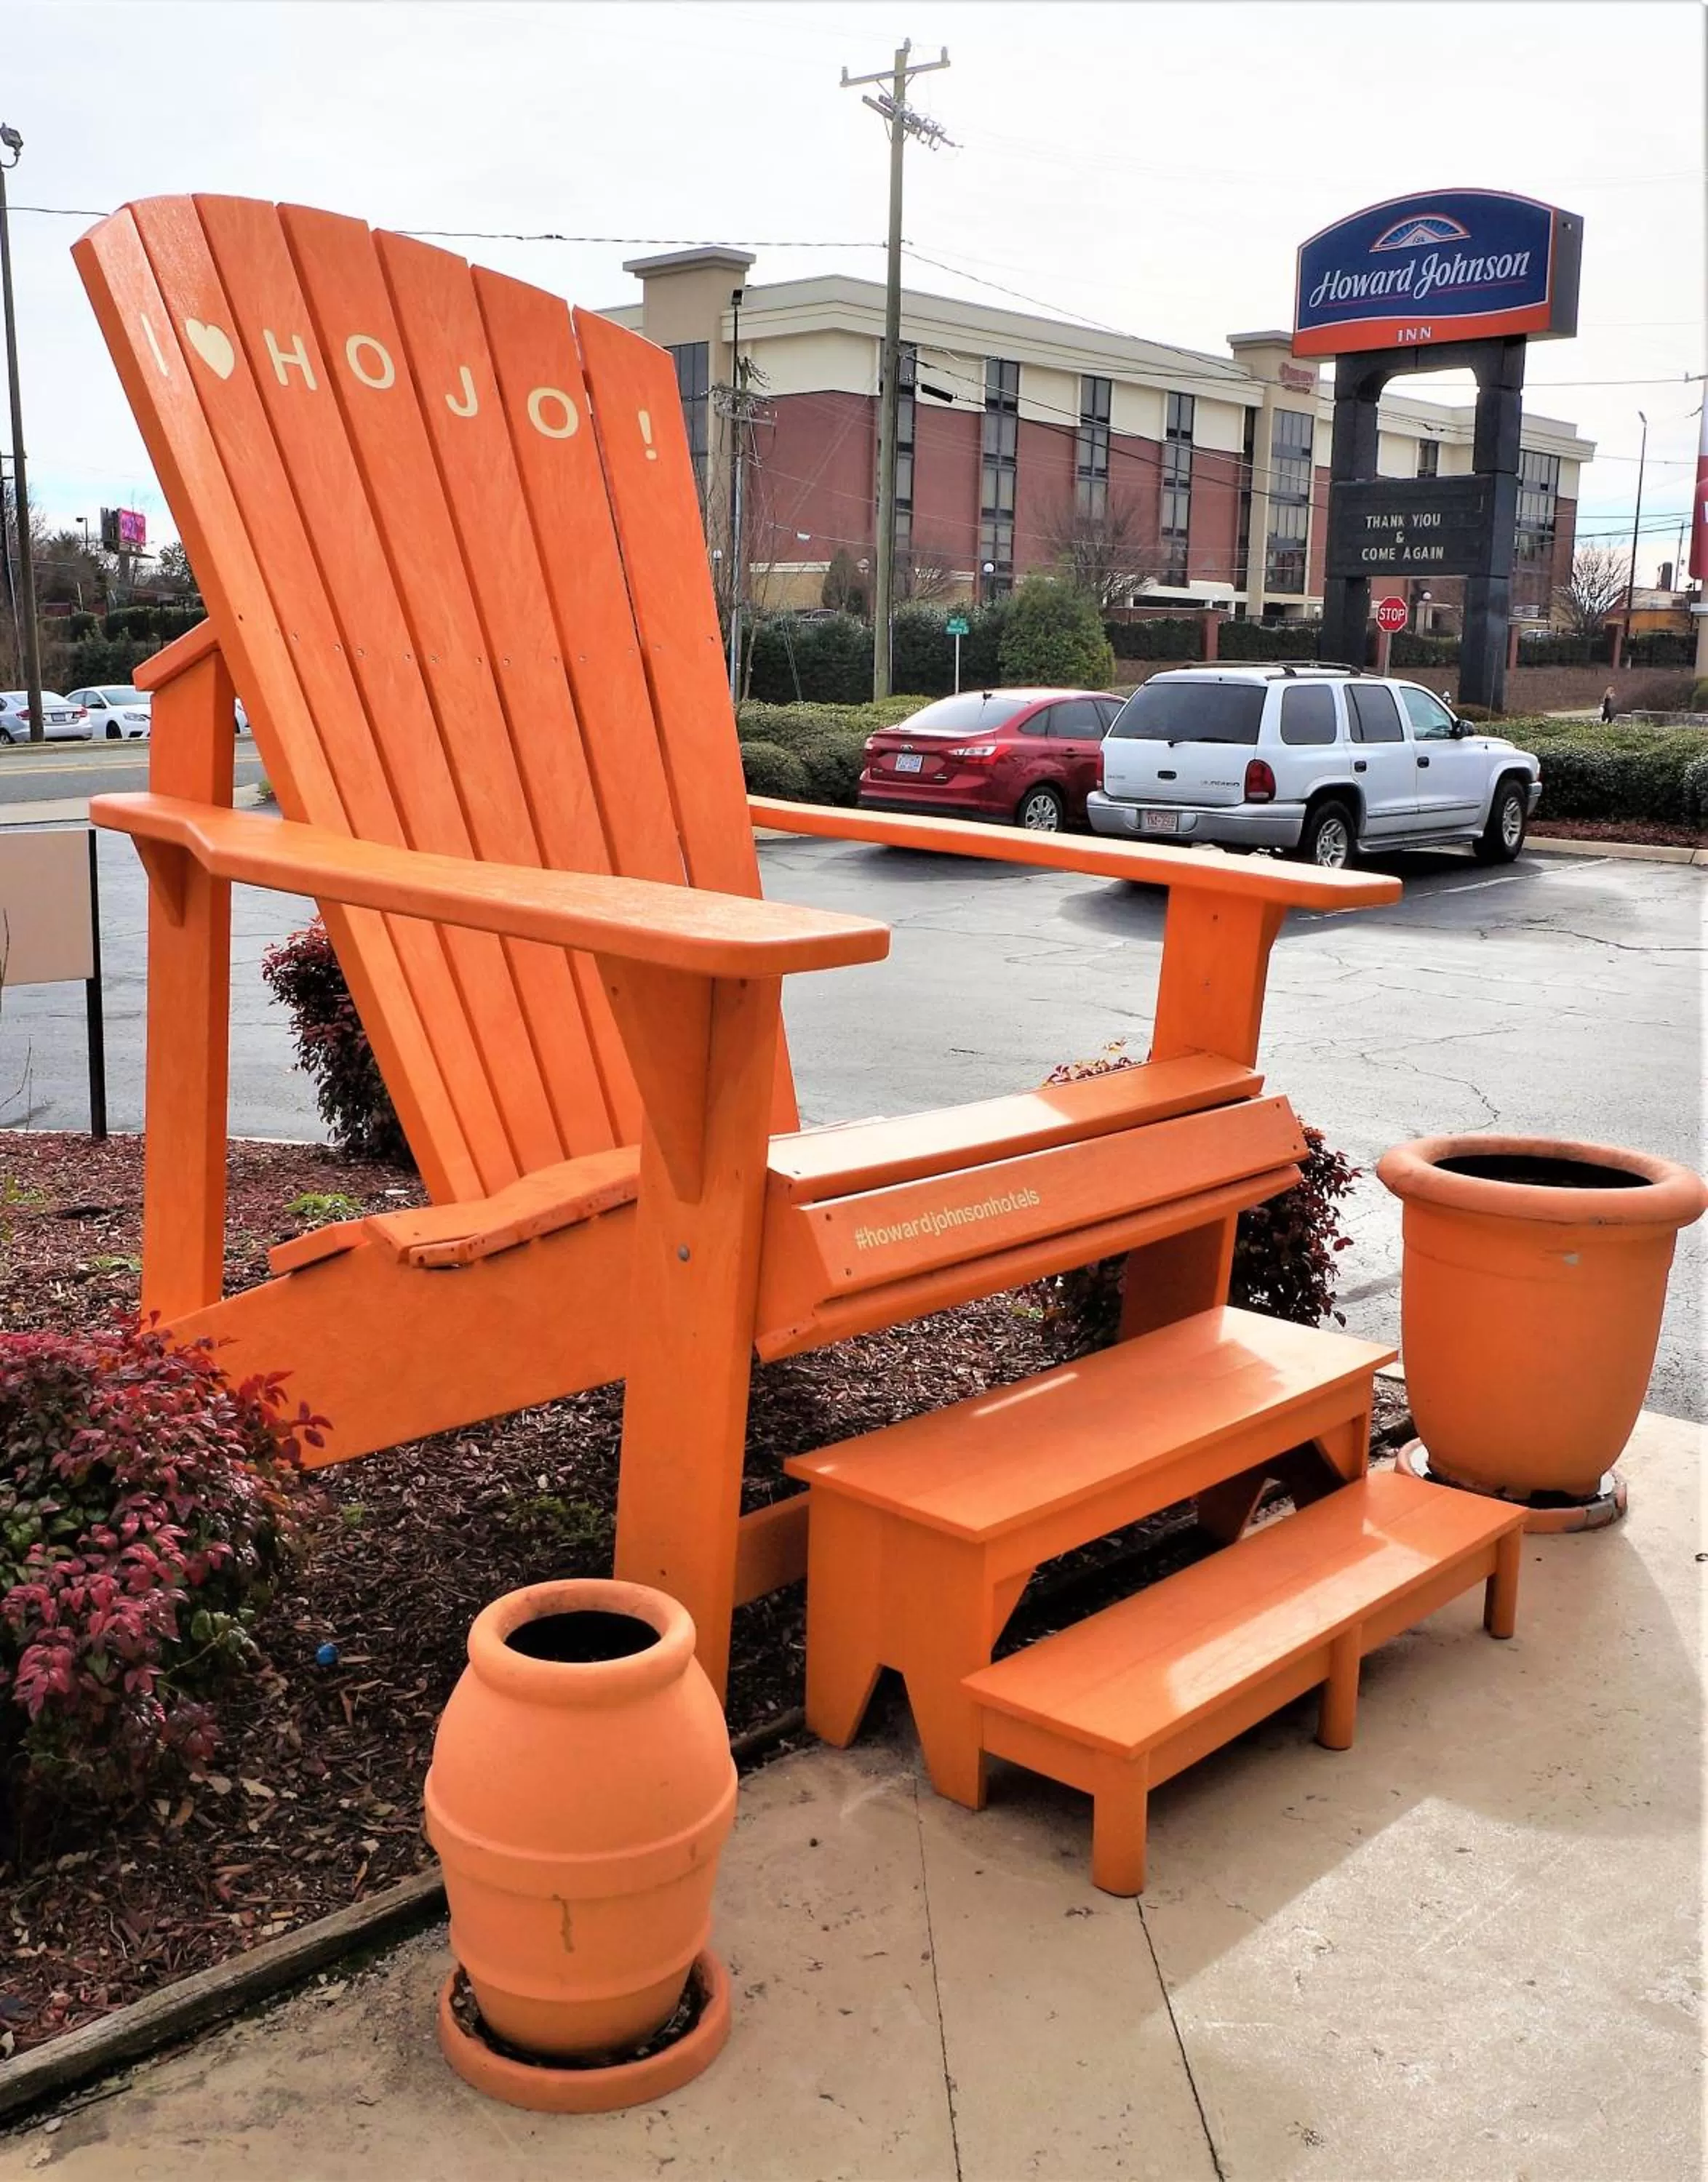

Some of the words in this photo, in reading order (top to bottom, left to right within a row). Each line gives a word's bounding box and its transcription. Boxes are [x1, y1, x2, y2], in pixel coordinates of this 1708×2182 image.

[1309, 258, 1416, 308] Howard
[1413, 252, 1531, 300] Johnson
[1397, 326, 1432, 342] INN
[142, 314, 168, 377] I
[1365, 515, 1405, 529] THANK
[1412, 513, 1442, 527] YOU
[1395, 531, 1405, 543] &
[1361, 548, 1397, 561] COME
[1402, 546, 1444, 560] AGAIN
[1378, 607, 1405, 622] STOP
[855, 1187, 1040, 1250] #howardjohnsonhotels
